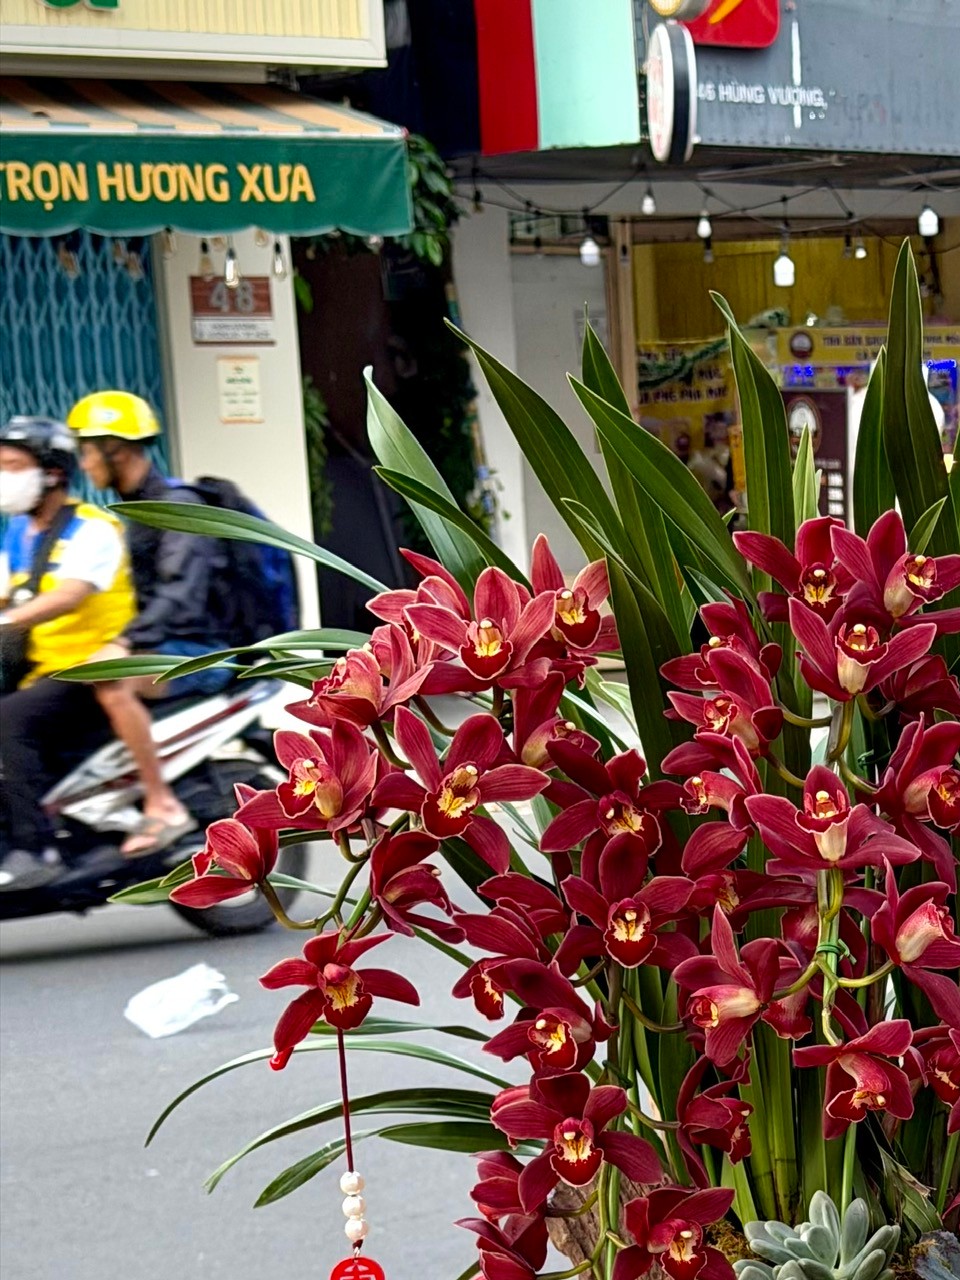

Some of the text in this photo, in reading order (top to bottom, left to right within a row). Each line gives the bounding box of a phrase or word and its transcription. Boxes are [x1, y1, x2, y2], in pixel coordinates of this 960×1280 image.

[97, 161, 230, 202] HƯƠNG
[236, 163, 316, 202] XƯA
[210, 280, 253, 313] 48
